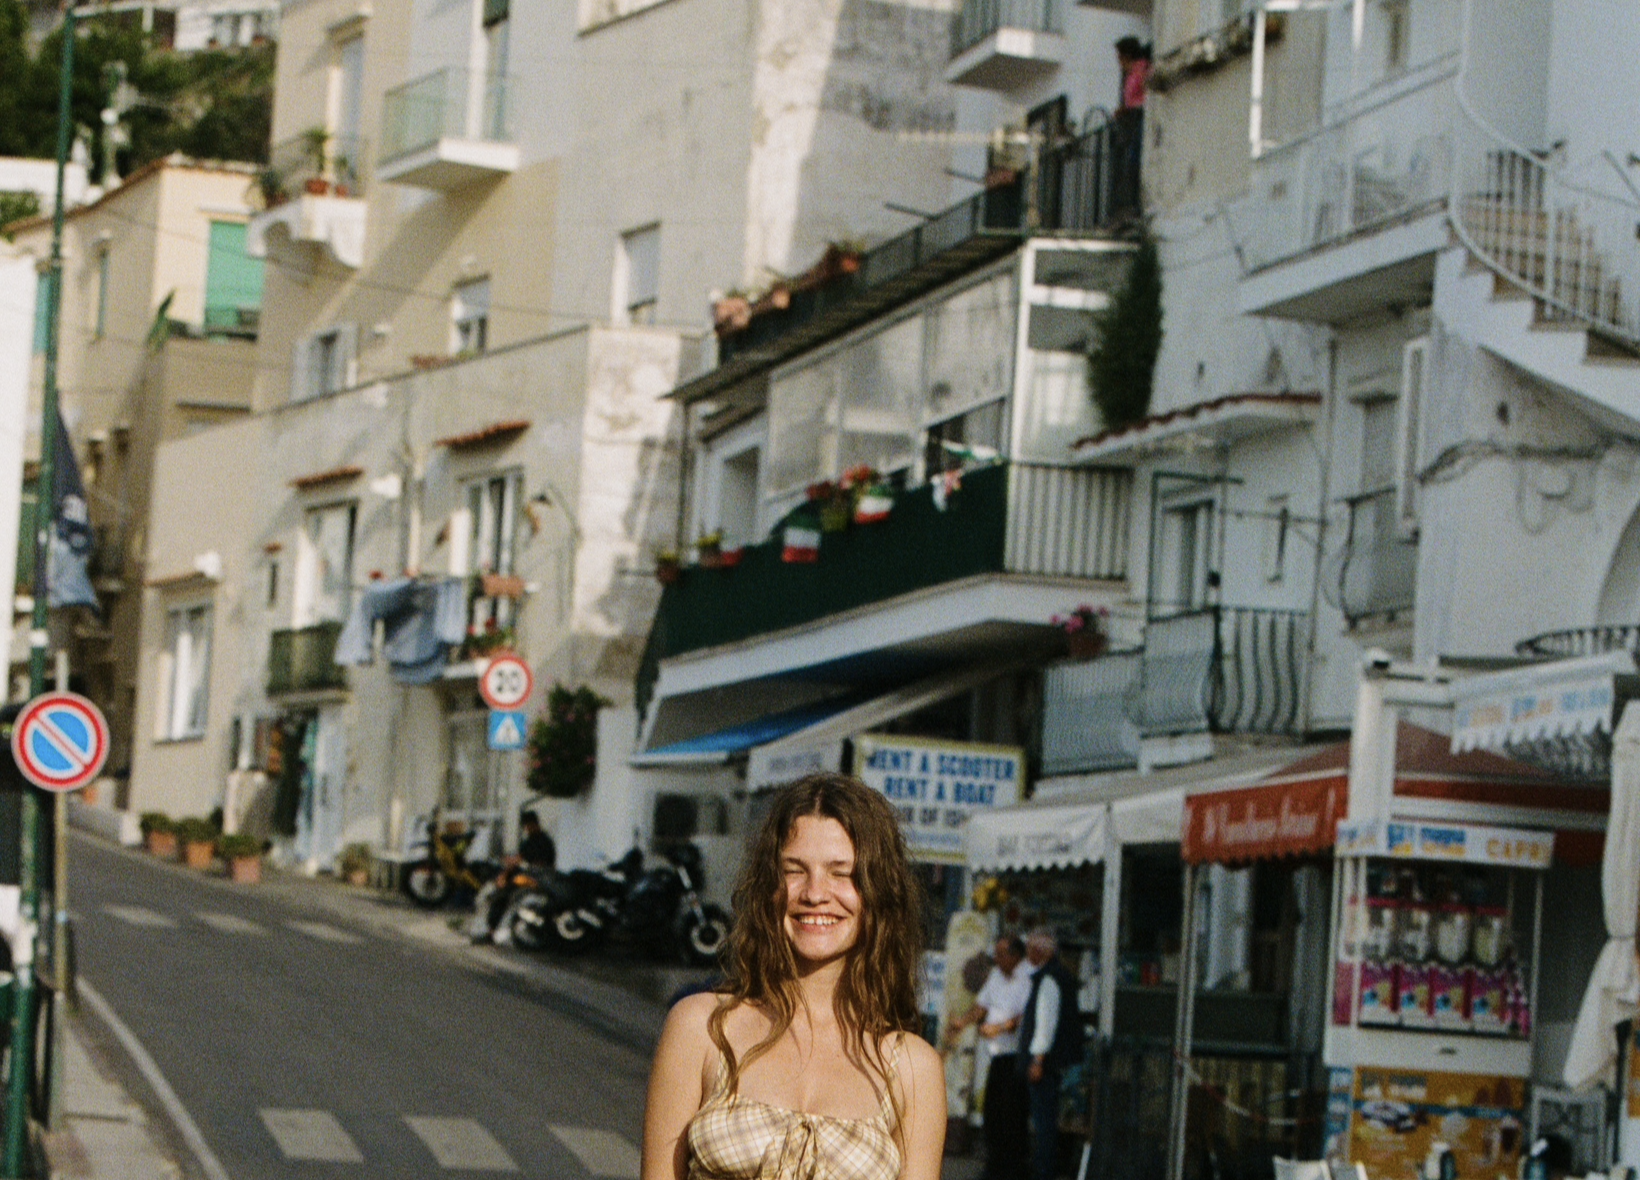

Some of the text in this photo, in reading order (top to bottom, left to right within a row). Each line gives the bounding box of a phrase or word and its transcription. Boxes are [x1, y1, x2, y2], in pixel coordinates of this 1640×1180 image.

[920, 752, 930, 773] A
[938, 754, 1014, 781] SCOOTER
[884, 776, 995, 804] RENT A BOAT
